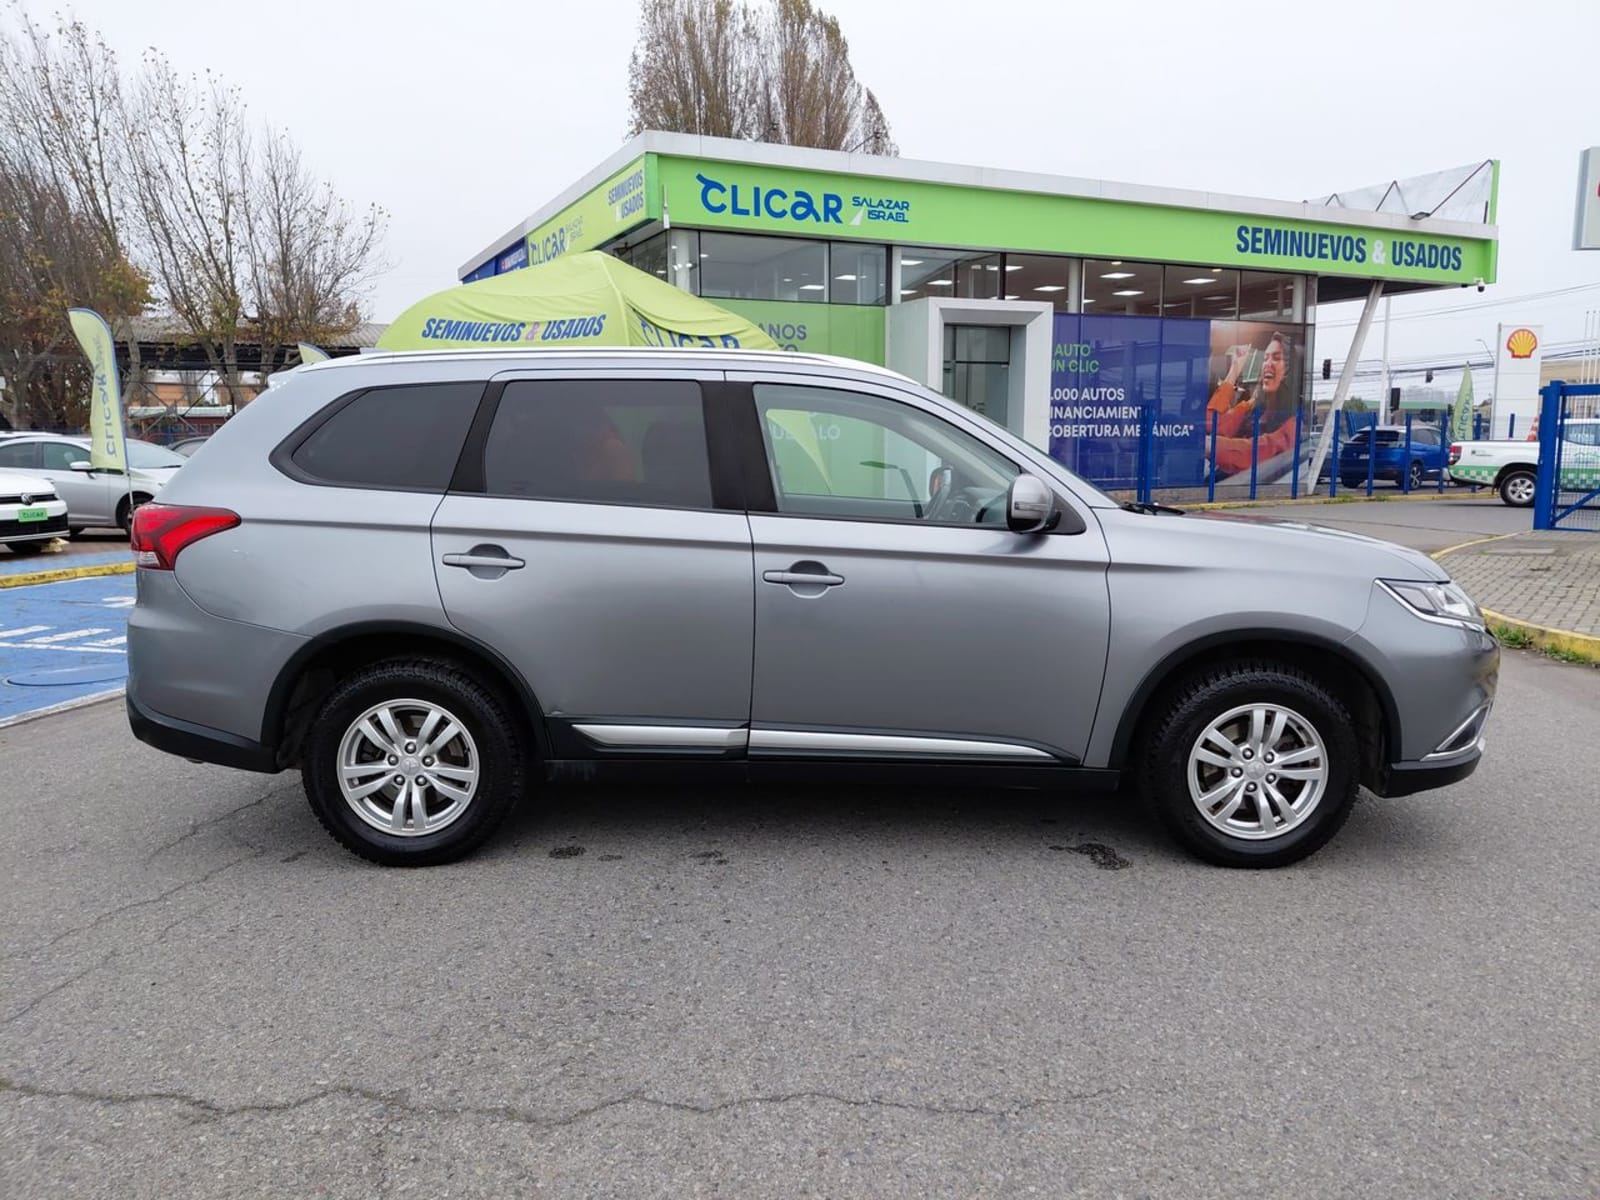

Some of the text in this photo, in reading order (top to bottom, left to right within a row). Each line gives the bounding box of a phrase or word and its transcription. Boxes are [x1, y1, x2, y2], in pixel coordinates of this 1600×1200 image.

[851, 196, 910, 211] SALAZAR
[867, 209, 909, 223] ISRAEL
[1236, 225, 1462, 271] SEMINUEVOS & USADOS
[421, 314, 607, 342] SEMINUEVOS & USADOS
[1055, 344, 1091, 357] AUTO
[1069, 359, 1100, 373] CLIC
[1082, 387, 1125, 402] AUTOS
[1050, 405, 1143, 419] INANCIAMIEN
